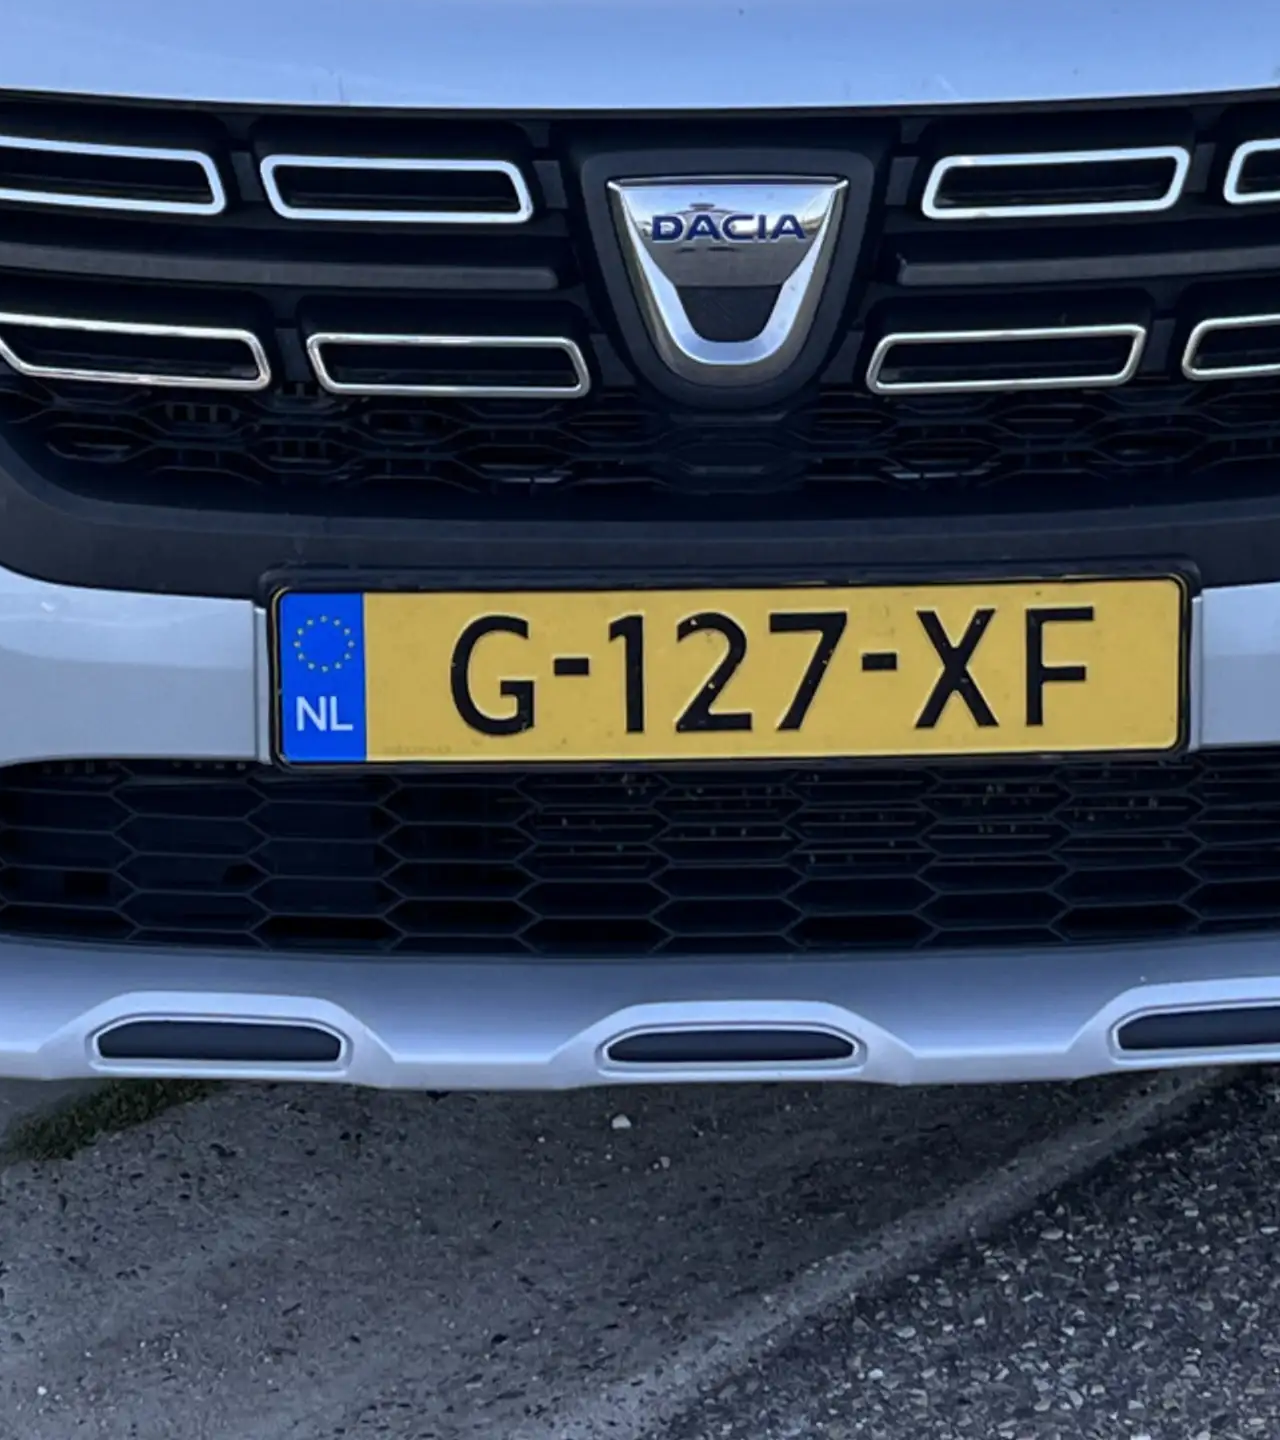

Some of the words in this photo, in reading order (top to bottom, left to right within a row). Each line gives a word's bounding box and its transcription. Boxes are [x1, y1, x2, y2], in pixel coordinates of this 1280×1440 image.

[652, 214, 805, 241] DACIA
[448, 606, 1095, 736] G-127-XF
[296, 696, 354, 731] NL
